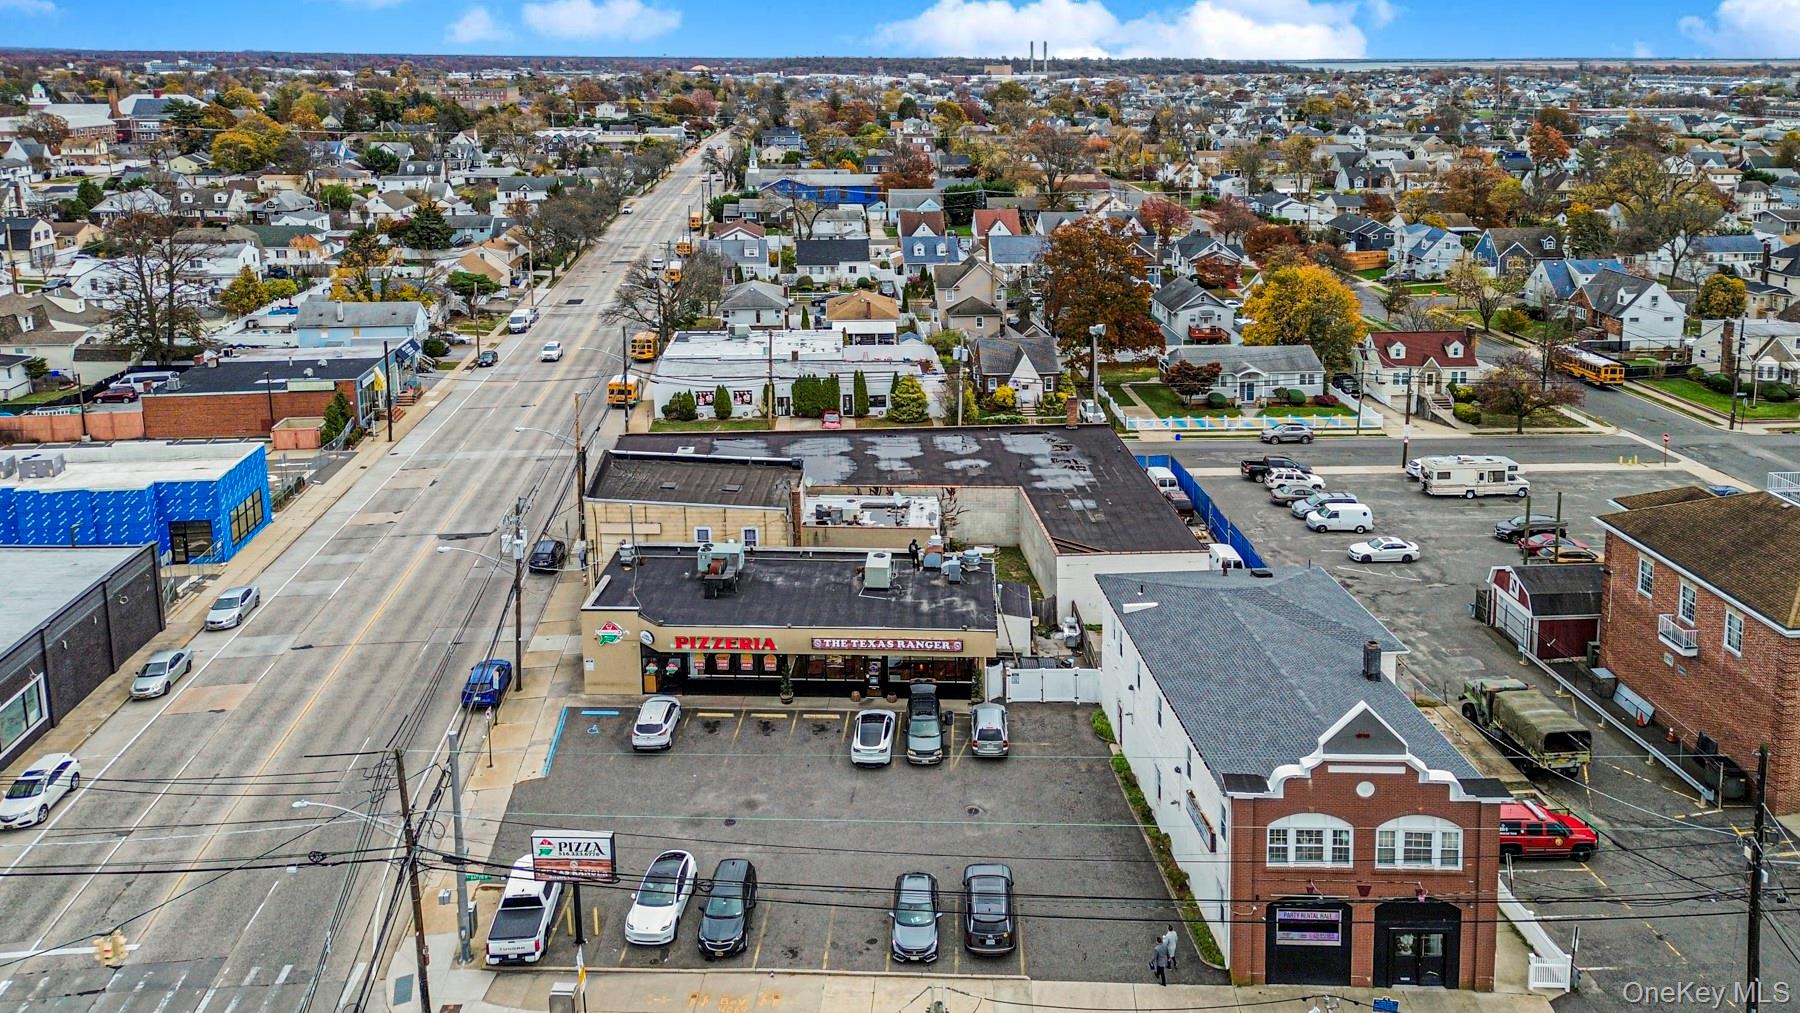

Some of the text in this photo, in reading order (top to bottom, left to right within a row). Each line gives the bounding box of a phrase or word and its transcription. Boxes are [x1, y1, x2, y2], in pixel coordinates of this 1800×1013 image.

[674, 636, 777, 651] PIZZERIA
[823, 639, 950, 650] THE TEXAS RANGER
[558, 841, 606, 856] PIZZA
[1283, 911, 1300, 919] PARTY
